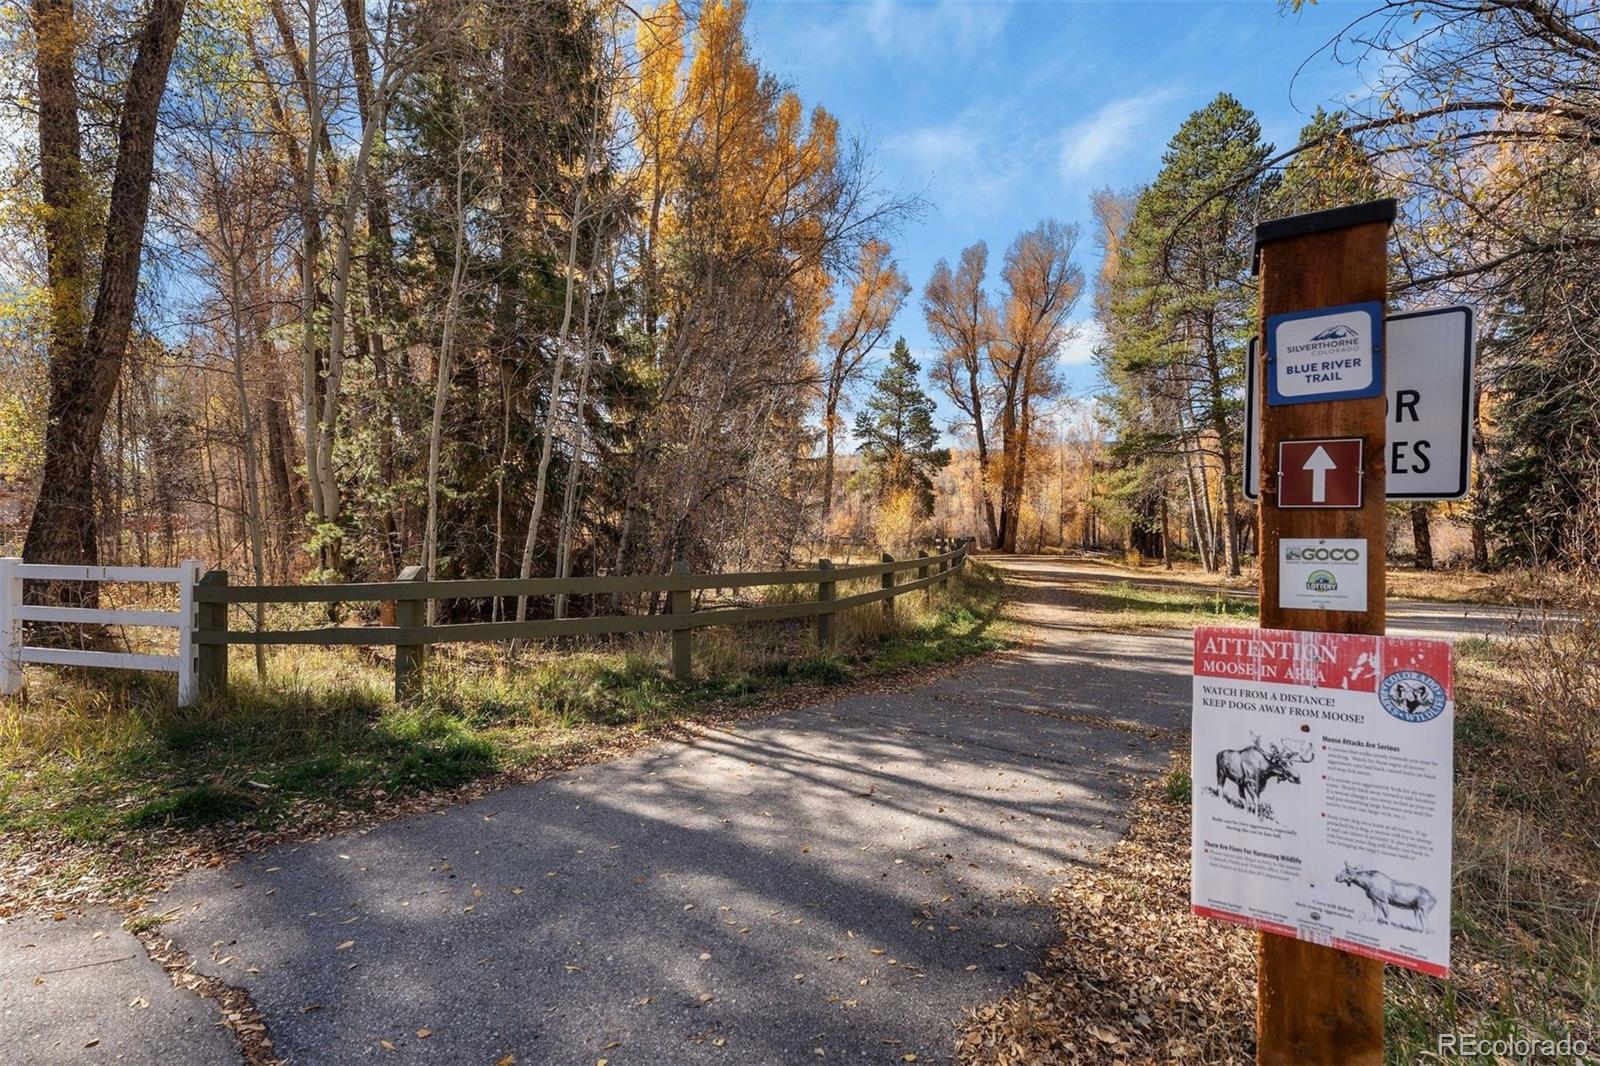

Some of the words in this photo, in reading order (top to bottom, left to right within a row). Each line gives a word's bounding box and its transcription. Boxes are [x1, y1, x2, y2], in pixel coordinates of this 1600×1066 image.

[1286, 337, 1359, 354] SILVERTHORNE
[1311, 345, 1360, 356] COLORADO
[1286, 362, 1318, 375] BLUE
[1321, 358, 1362, 371] RIVER
[1305, 372, 1342, 383] TRAIL
[1386, 390, 1420, 423] R
[1301, 548, 1359, 561] GOCO
[1202, 636, 1337, 664] ATTENTION
[1203, 659, 1253, 675] MOOSE
[1261, 664, 1278, 677] IN
[1284, 667, 1325, 682] AREA
[1202, 685, 1237, 696] WATCH
[1239, 689, 1267, 699] FROM
[1270, 692, 1276, 700] A
[1280, 693, 1335, 707] DISTANCE!
[1202, 697, 1226, 708] KEEP
[1228, 700, 1255, 711] DOGS
[1258, 703, 1286, 715] AWAY
[1289, 706, 1319, 718] FROM
[1321, 710, 1364, 723] MOOSE!
[1322, 735, 1340, 744] Moose
[1342, 737, 1364, 747] Attacks
[1377, 742, 1400, 752] Serious
